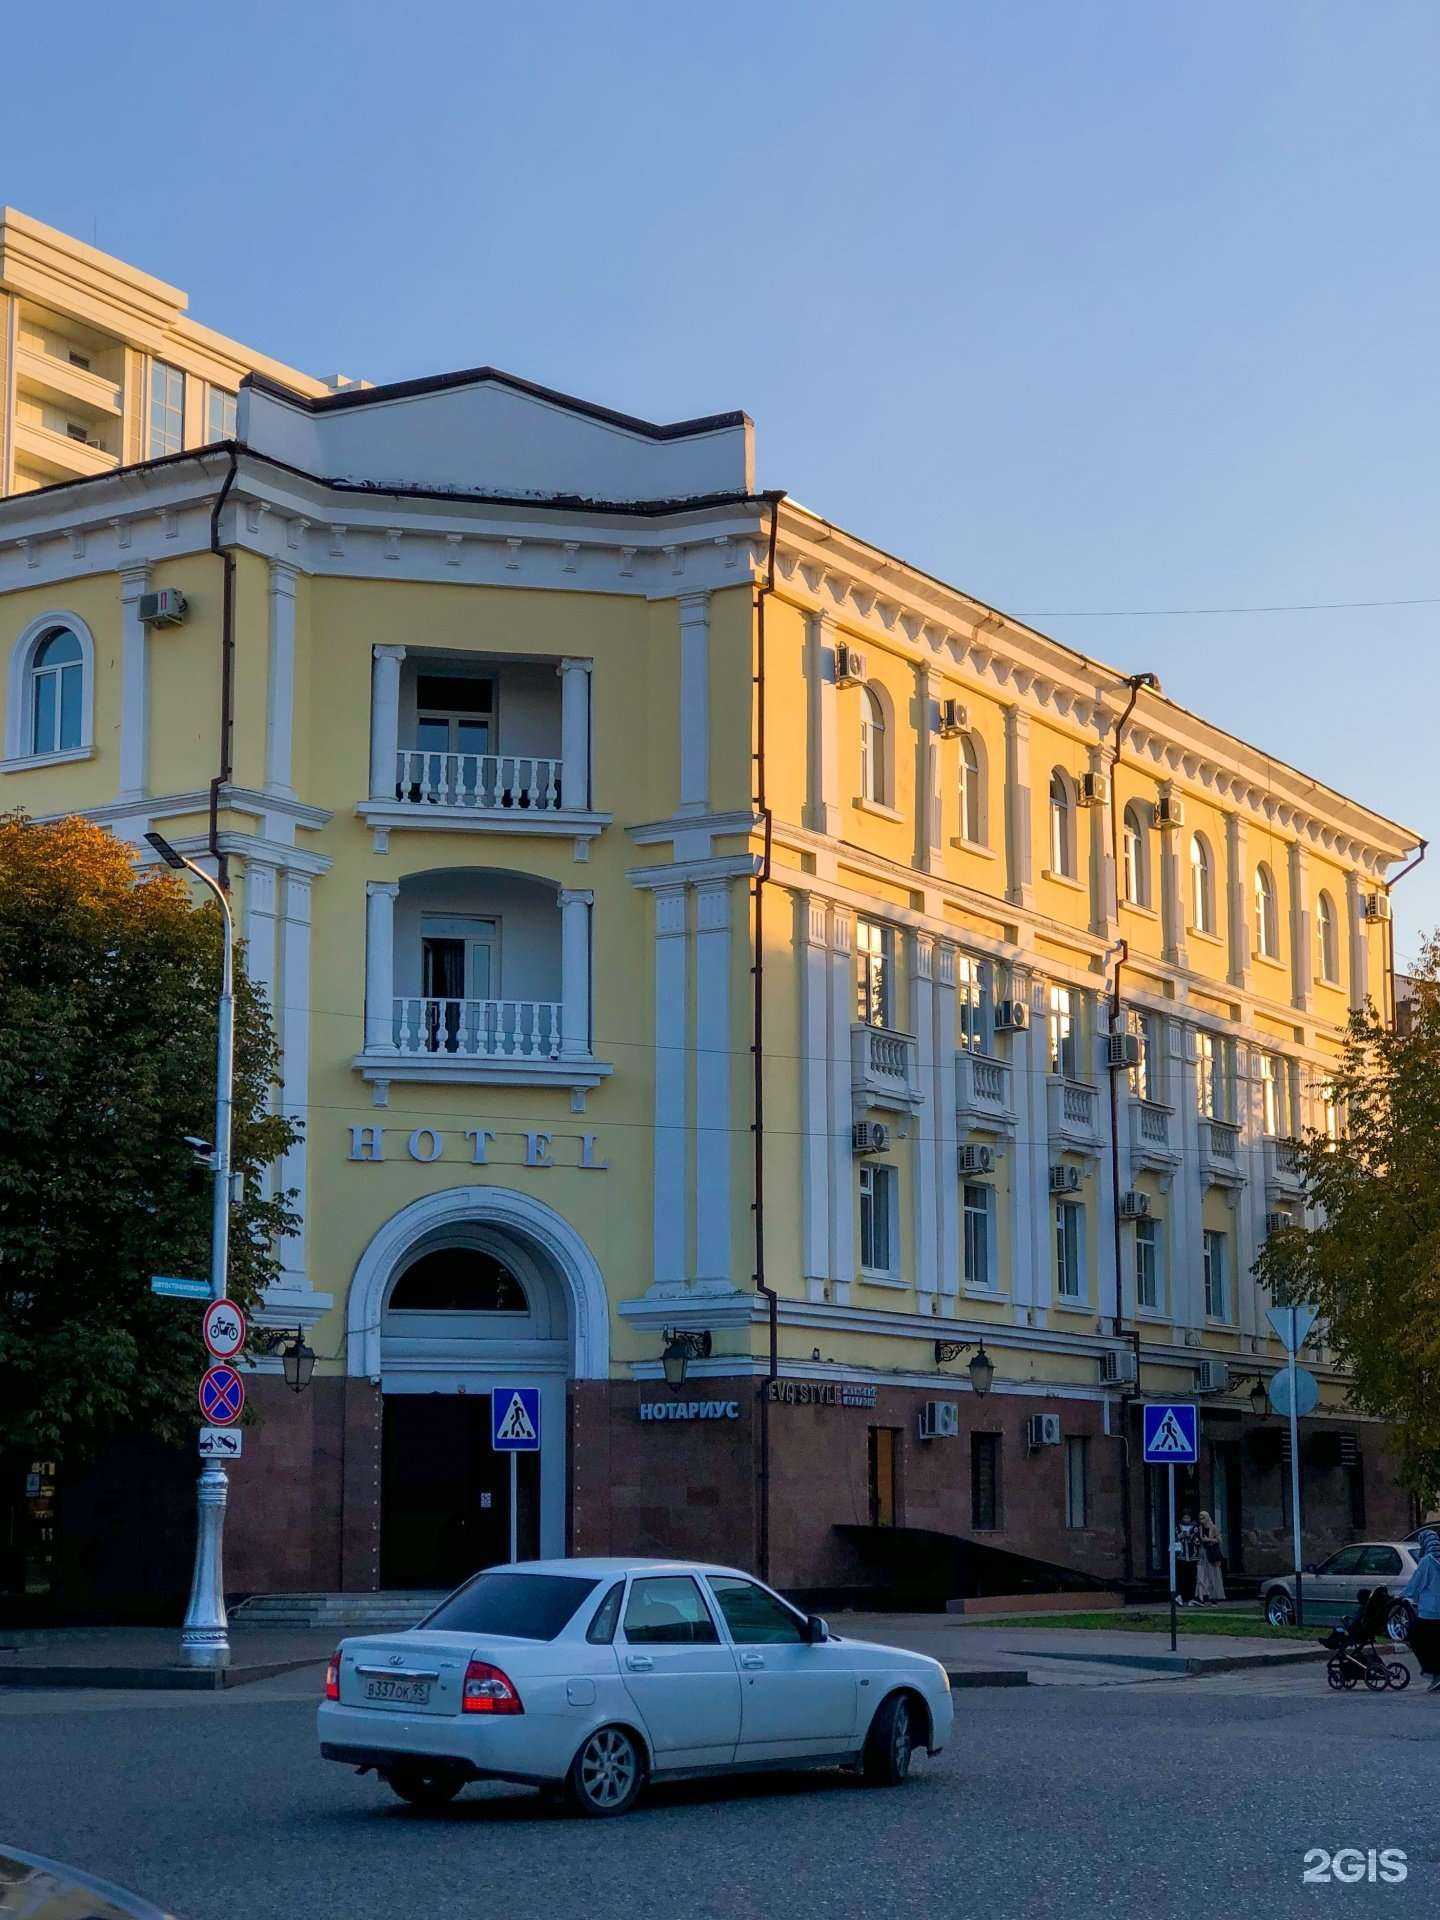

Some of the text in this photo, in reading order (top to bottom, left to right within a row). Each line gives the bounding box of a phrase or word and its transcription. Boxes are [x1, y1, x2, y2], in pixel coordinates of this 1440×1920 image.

[348, 1125, 608, 1169] HOTEL
[800, 1383, 842, 1405] STYLE
[640, 1402, 739, 1419] НОТАРИУС
